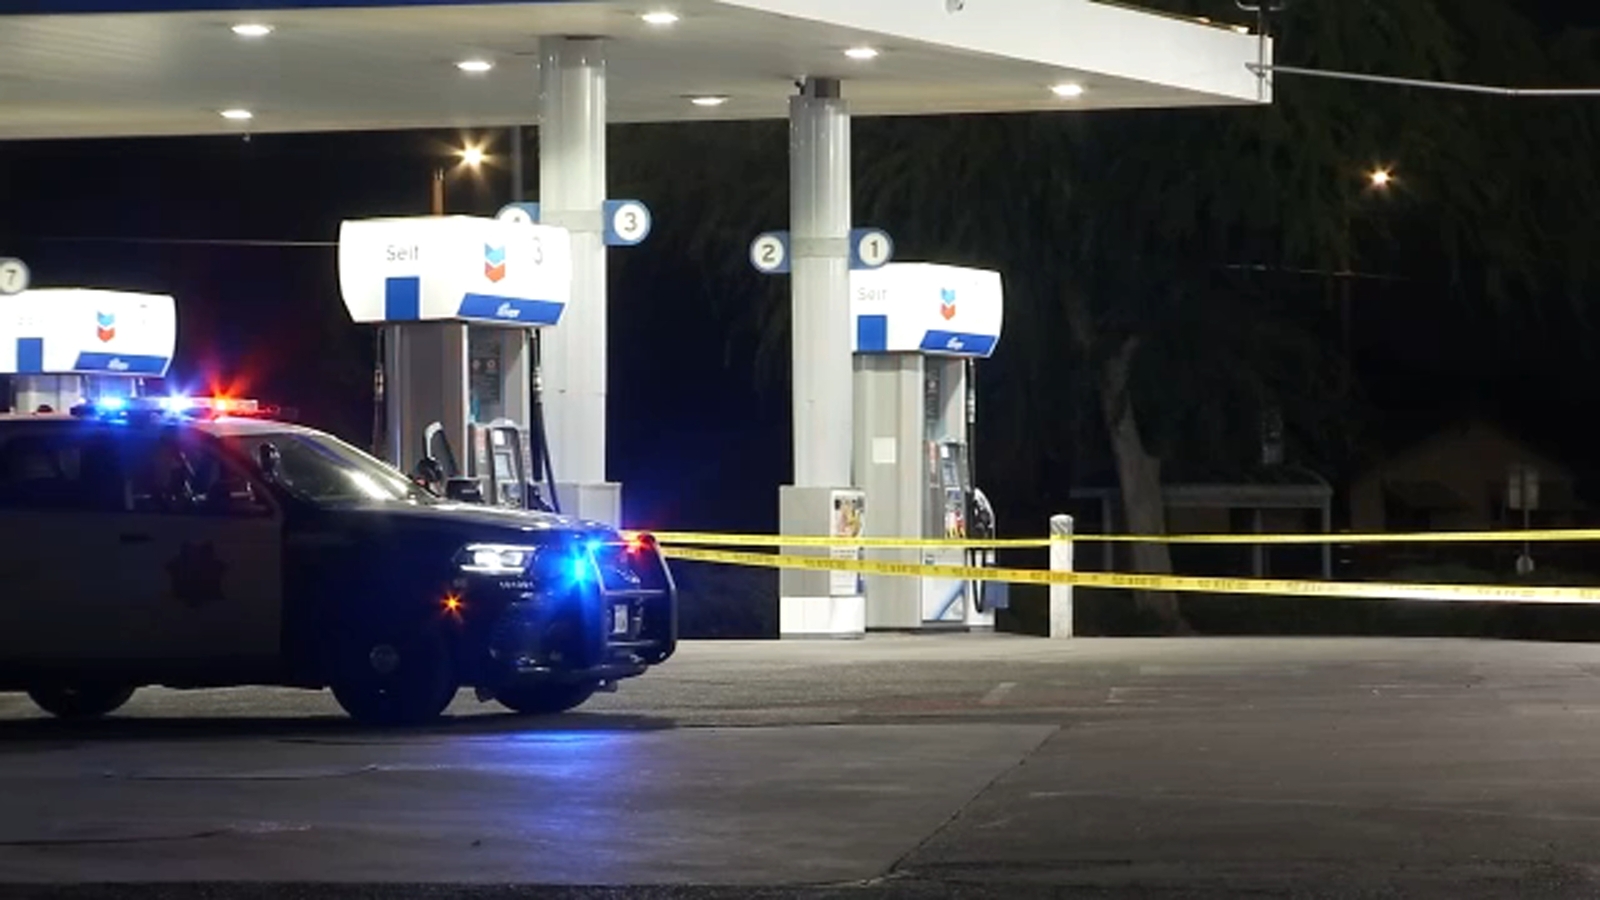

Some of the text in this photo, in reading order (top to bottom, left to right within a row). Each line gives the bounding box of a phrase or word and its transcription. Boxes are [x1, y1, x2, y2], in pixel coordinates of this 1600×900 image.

[624, 212, 638, 232] 3
[761, 243, 776, 263] 2
[869, 241, 878, 258] 1
[5, 269, 17, 286] 7
